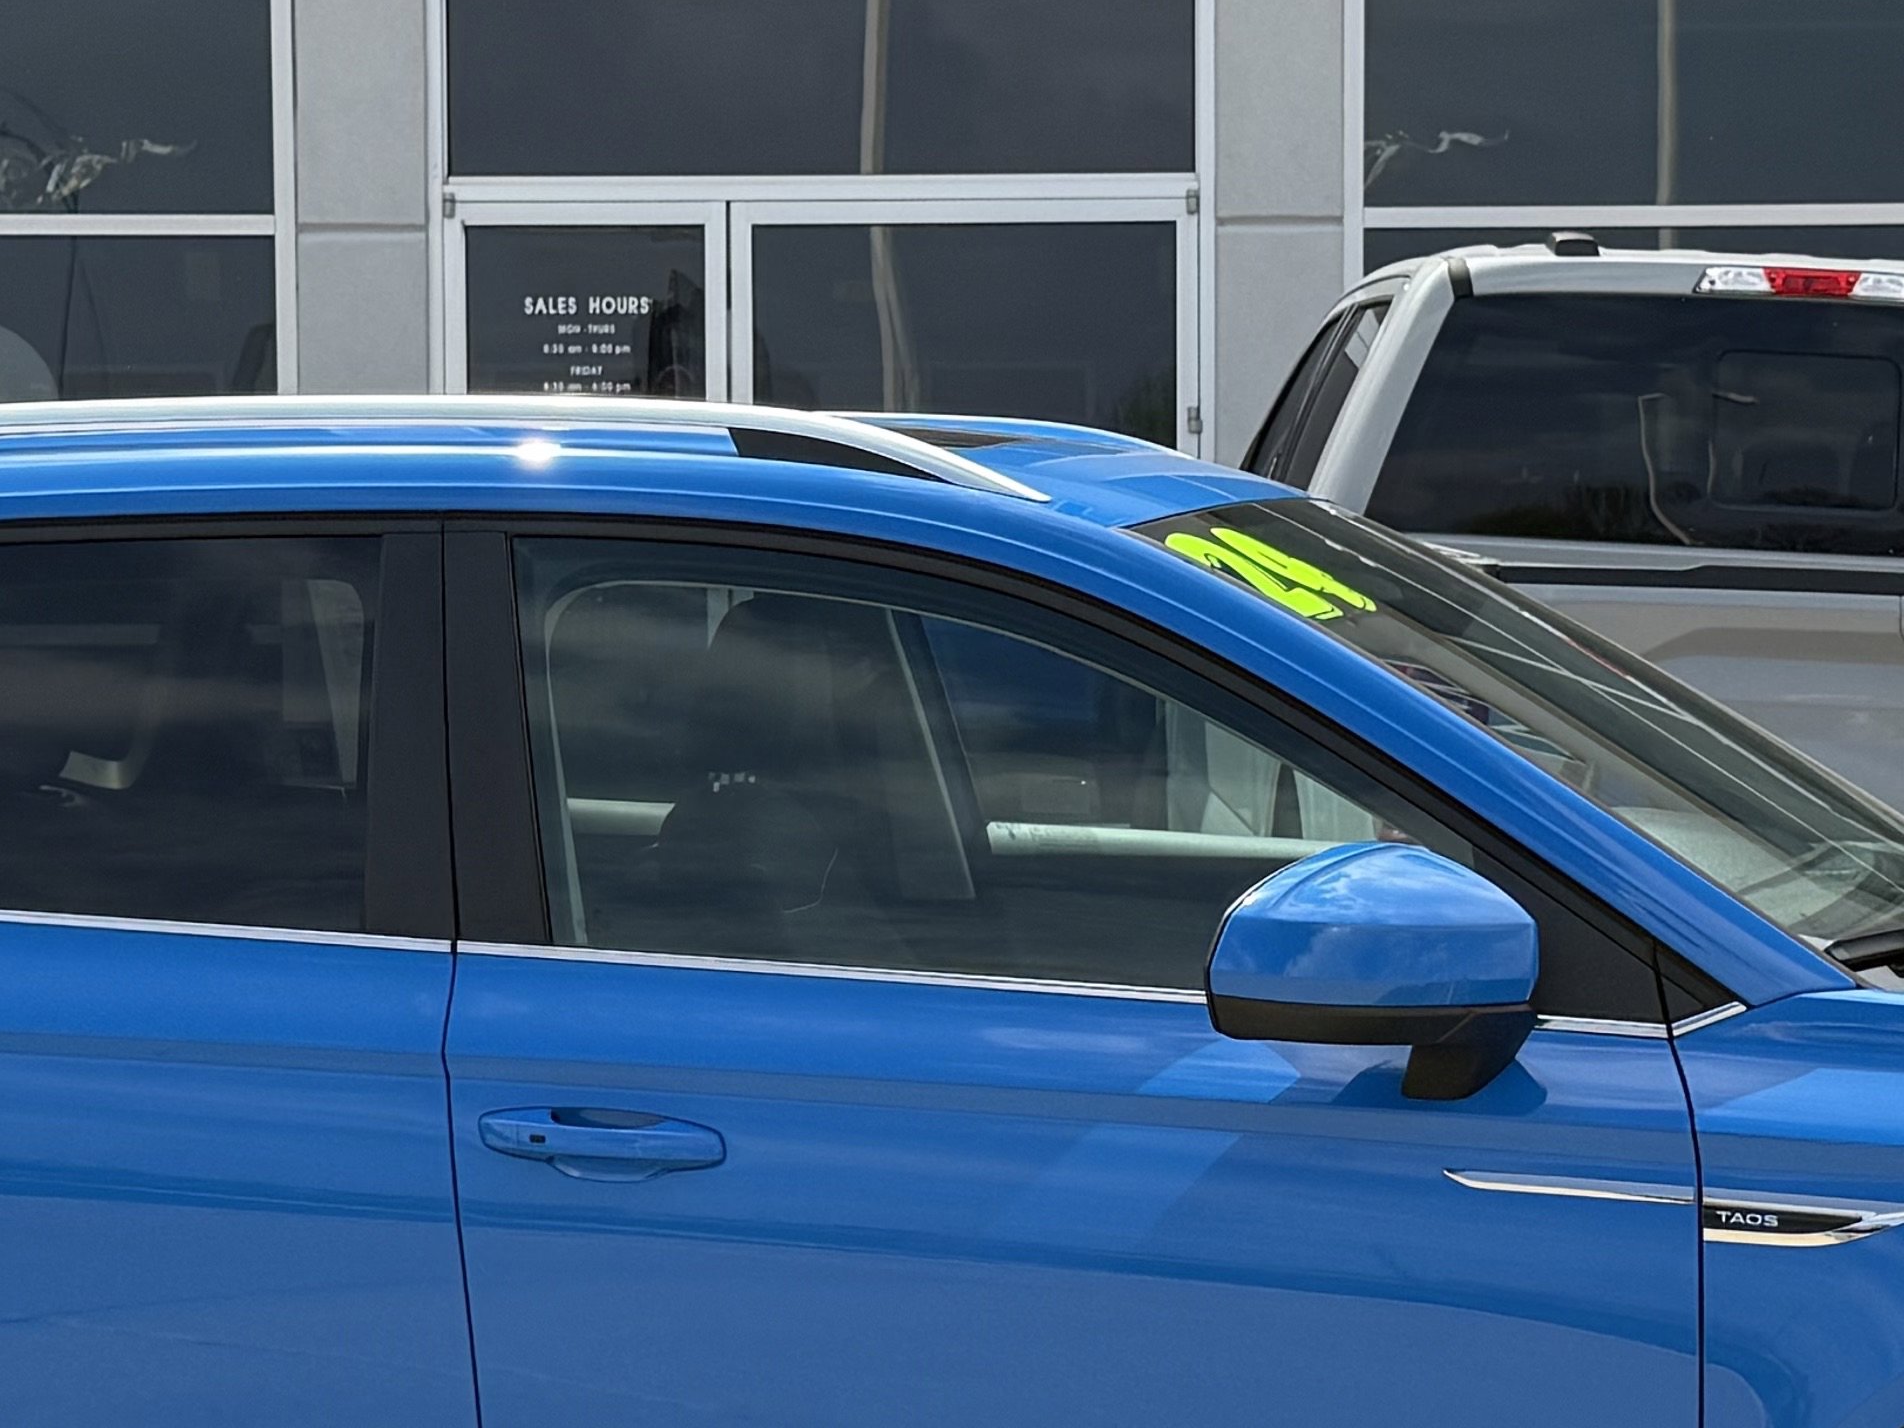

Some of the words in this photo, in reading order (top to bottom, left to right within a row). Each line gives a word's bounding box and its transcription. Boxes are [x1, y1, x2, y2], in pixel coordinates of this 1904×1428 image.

[524, 296, 578, 315] SALES
[589, 296, 650, 315] HOURS
[1164, 527, 1377, 620] 24
[1715, 1210, 1779, 1227] TAOS
